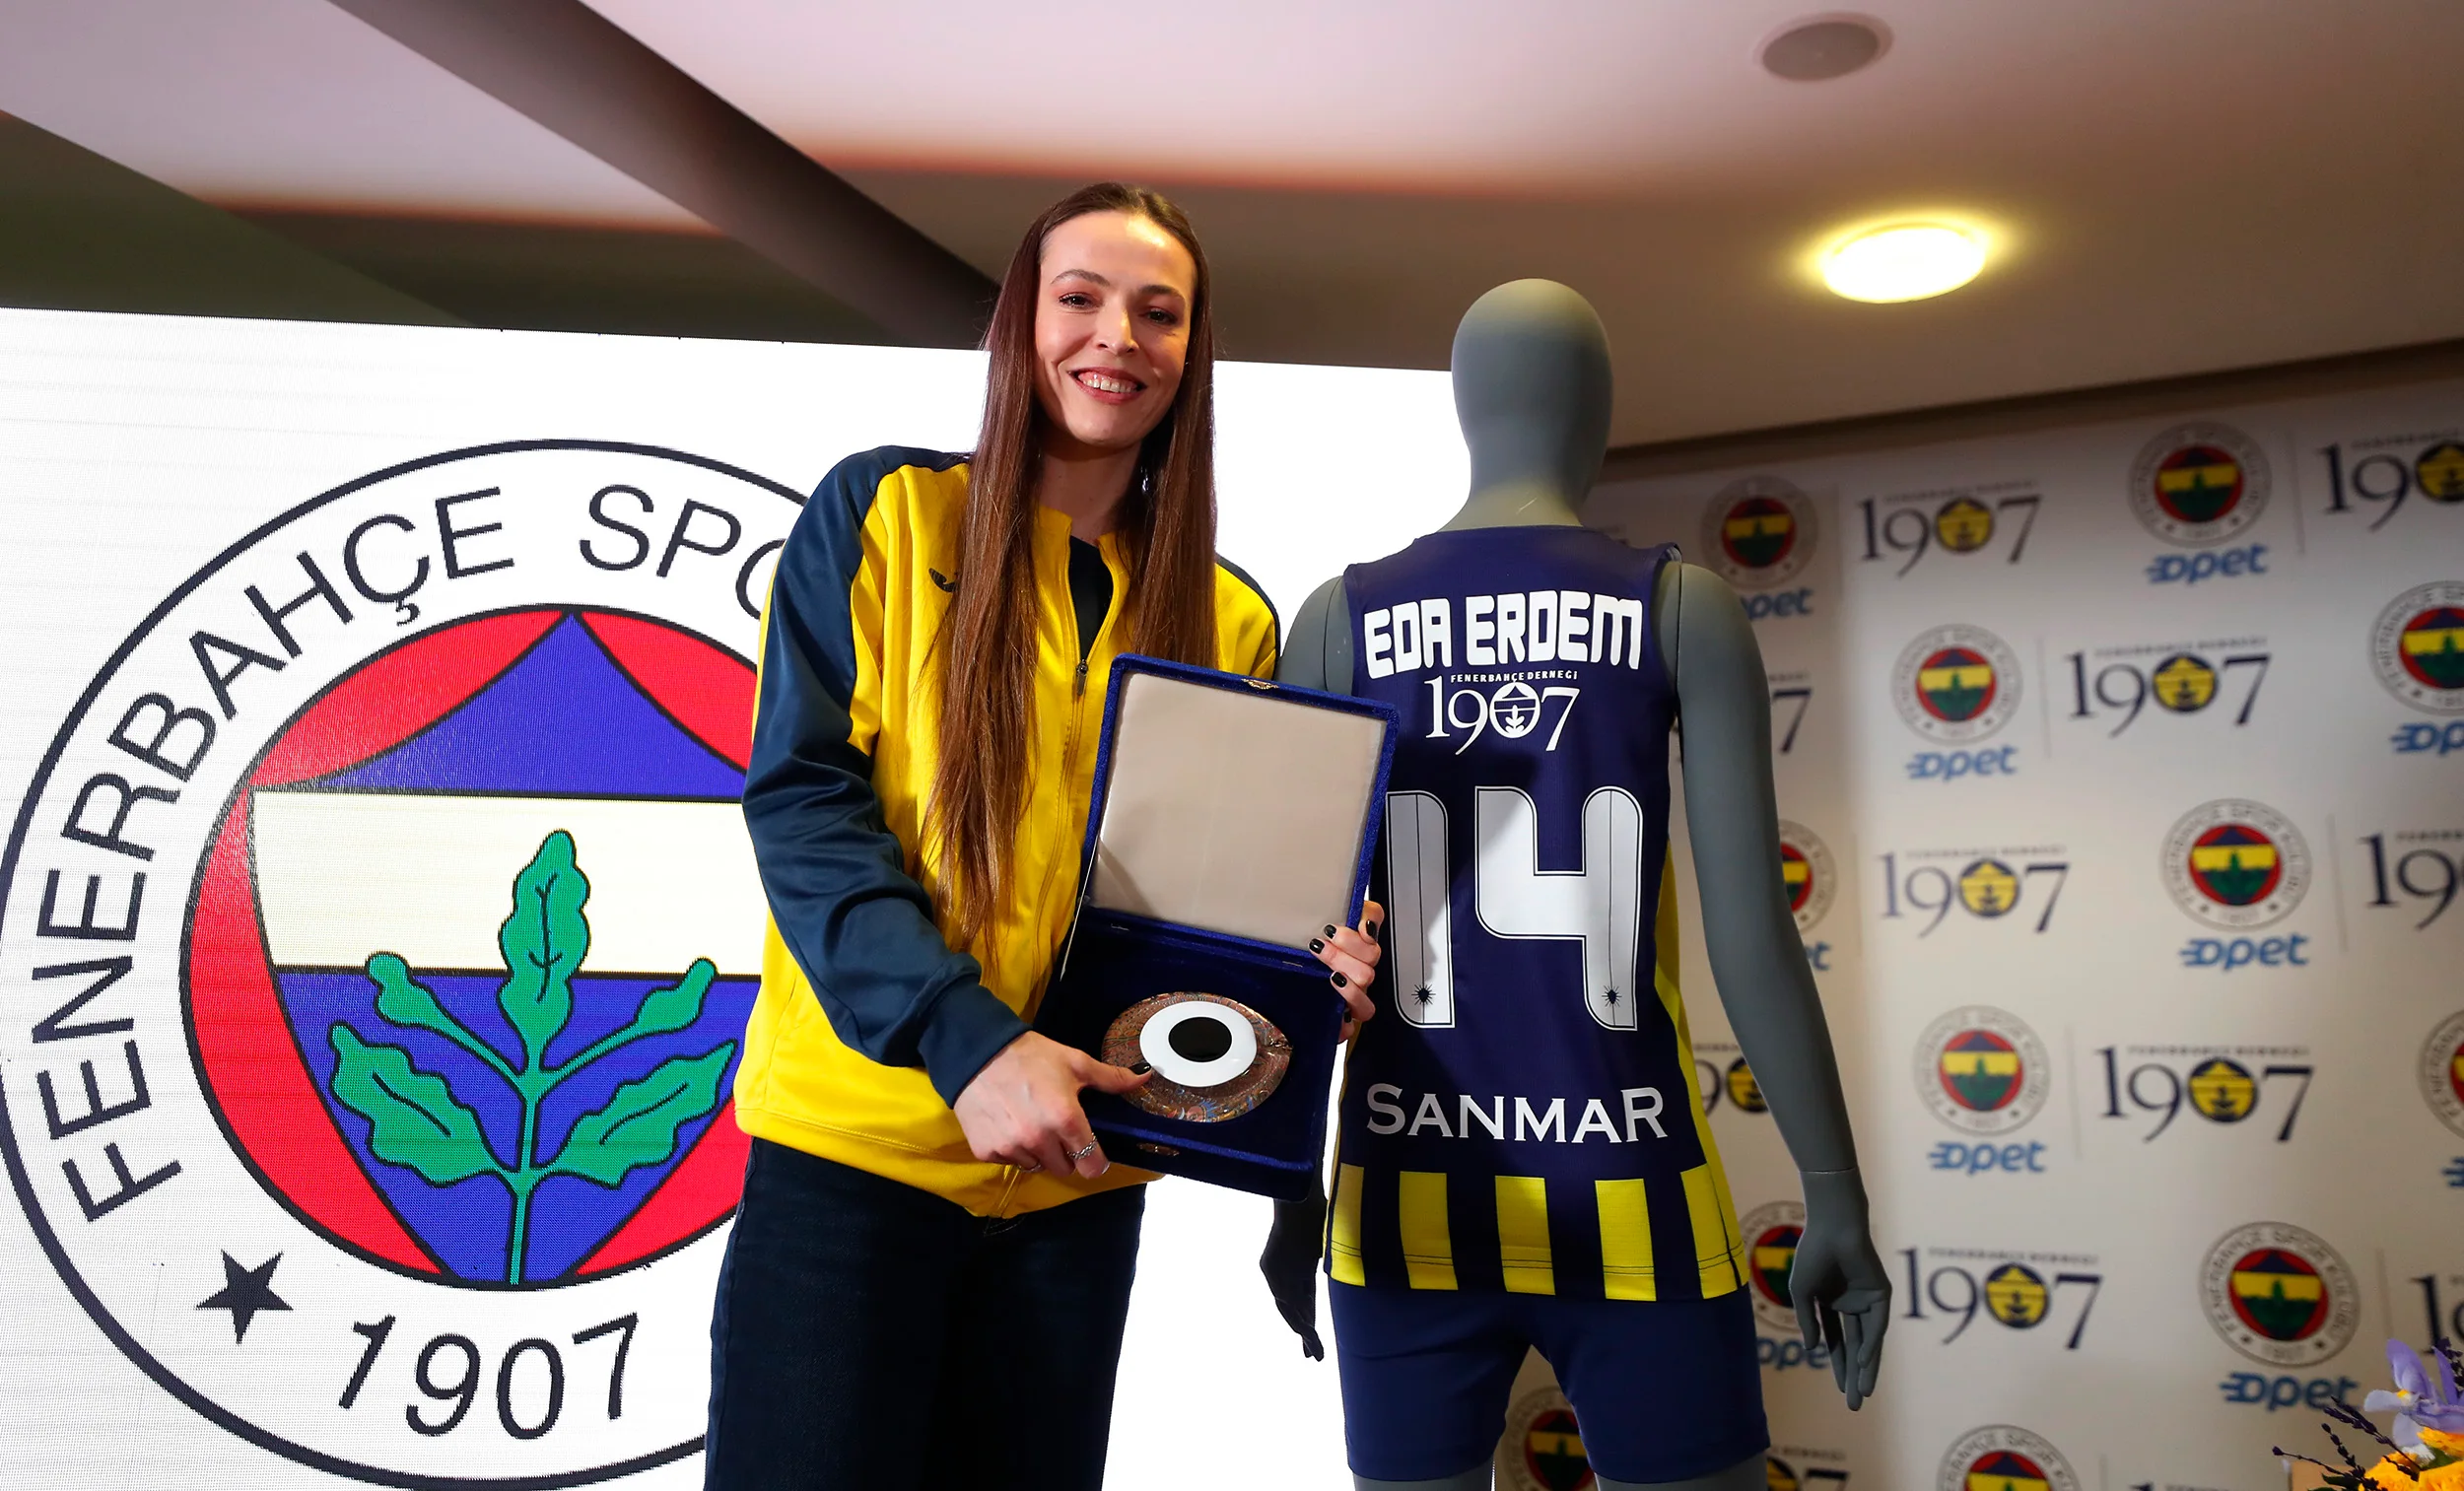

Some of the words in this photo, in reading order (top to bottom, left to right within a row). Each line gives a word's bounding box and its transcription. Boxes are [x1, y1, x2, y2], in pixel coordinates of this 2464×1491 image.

[2316, 442, 2464, 533] 190
[1858, 494, 2042, 579] 1907
[2145, 542, 2270, 584] opet
[1363, 597, 1452, 680] EDA
[1465, 589, 1644, 671] ERDEM
[1740, 588, 1814, 621] pet
[1424, 675, 1581, 756] 1907
[1450, 671, 1526, 684] FENERBAHÇE
[2065, 649, 2272, 738] 1907
[1906, 746, 2019, 781] opet
[2389, 719, 2464, 758] op
[32, 486, 514, 1223] FENERBAHÇE
[1877, 851, 2071, 939] 1907
[2361, 832, 2464, 931] 19
[1386, 785, 1644, 1032] 14
[2180, 932, 2310, 972] opet
[1366, 1082, 1669, 1144] SANMAR
[2095, 1045, 2314, 1144] 1907
[1928, 1140, 2047, 1176] opet
[1896, 1247, 2104, 1350] 1907
[338, 1312, 640, 1441] 1907
[1756, 1336, 1831, 1371] ope
